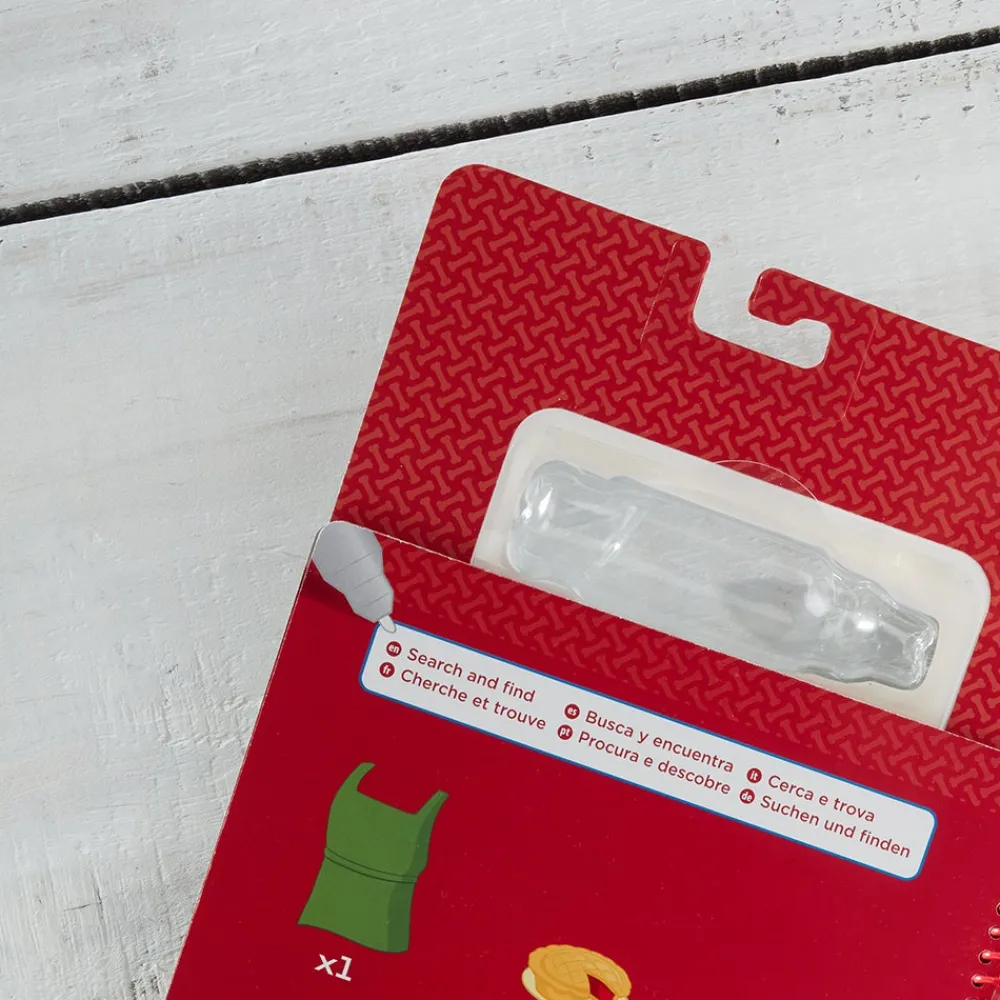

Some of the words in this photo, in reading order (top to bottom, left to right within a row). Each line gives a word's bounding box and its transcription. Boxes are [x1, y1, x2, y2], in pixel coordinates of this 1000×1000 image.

[400, 669, 468, 703] Cherche
[472, 696, 490, 711] et
[493, 701, 546, 730] trouve
[406, 647, 463, 678] Search
[466, 671, 500, 690] and
[502, 680, 536, 703] find
[578, 730, 640, 763] Procura
[643, 756, 654, 768] e
[657, 760, 731, 795] descobre
[585, 710, 634, 738] Busca
[637, 730, 649, 744] y
[652, 736, 734, 773] encuentra
[760, 795, 820, 826] Suchen
[823, 819, 857, 839] und
[859, 829, 911, 858] finden
[768, 774, 814, 801] Cerca
[818, 795, 829, 806] e
[833, 797, 875, 823] trova
[314, 953, 352, 982] x1
